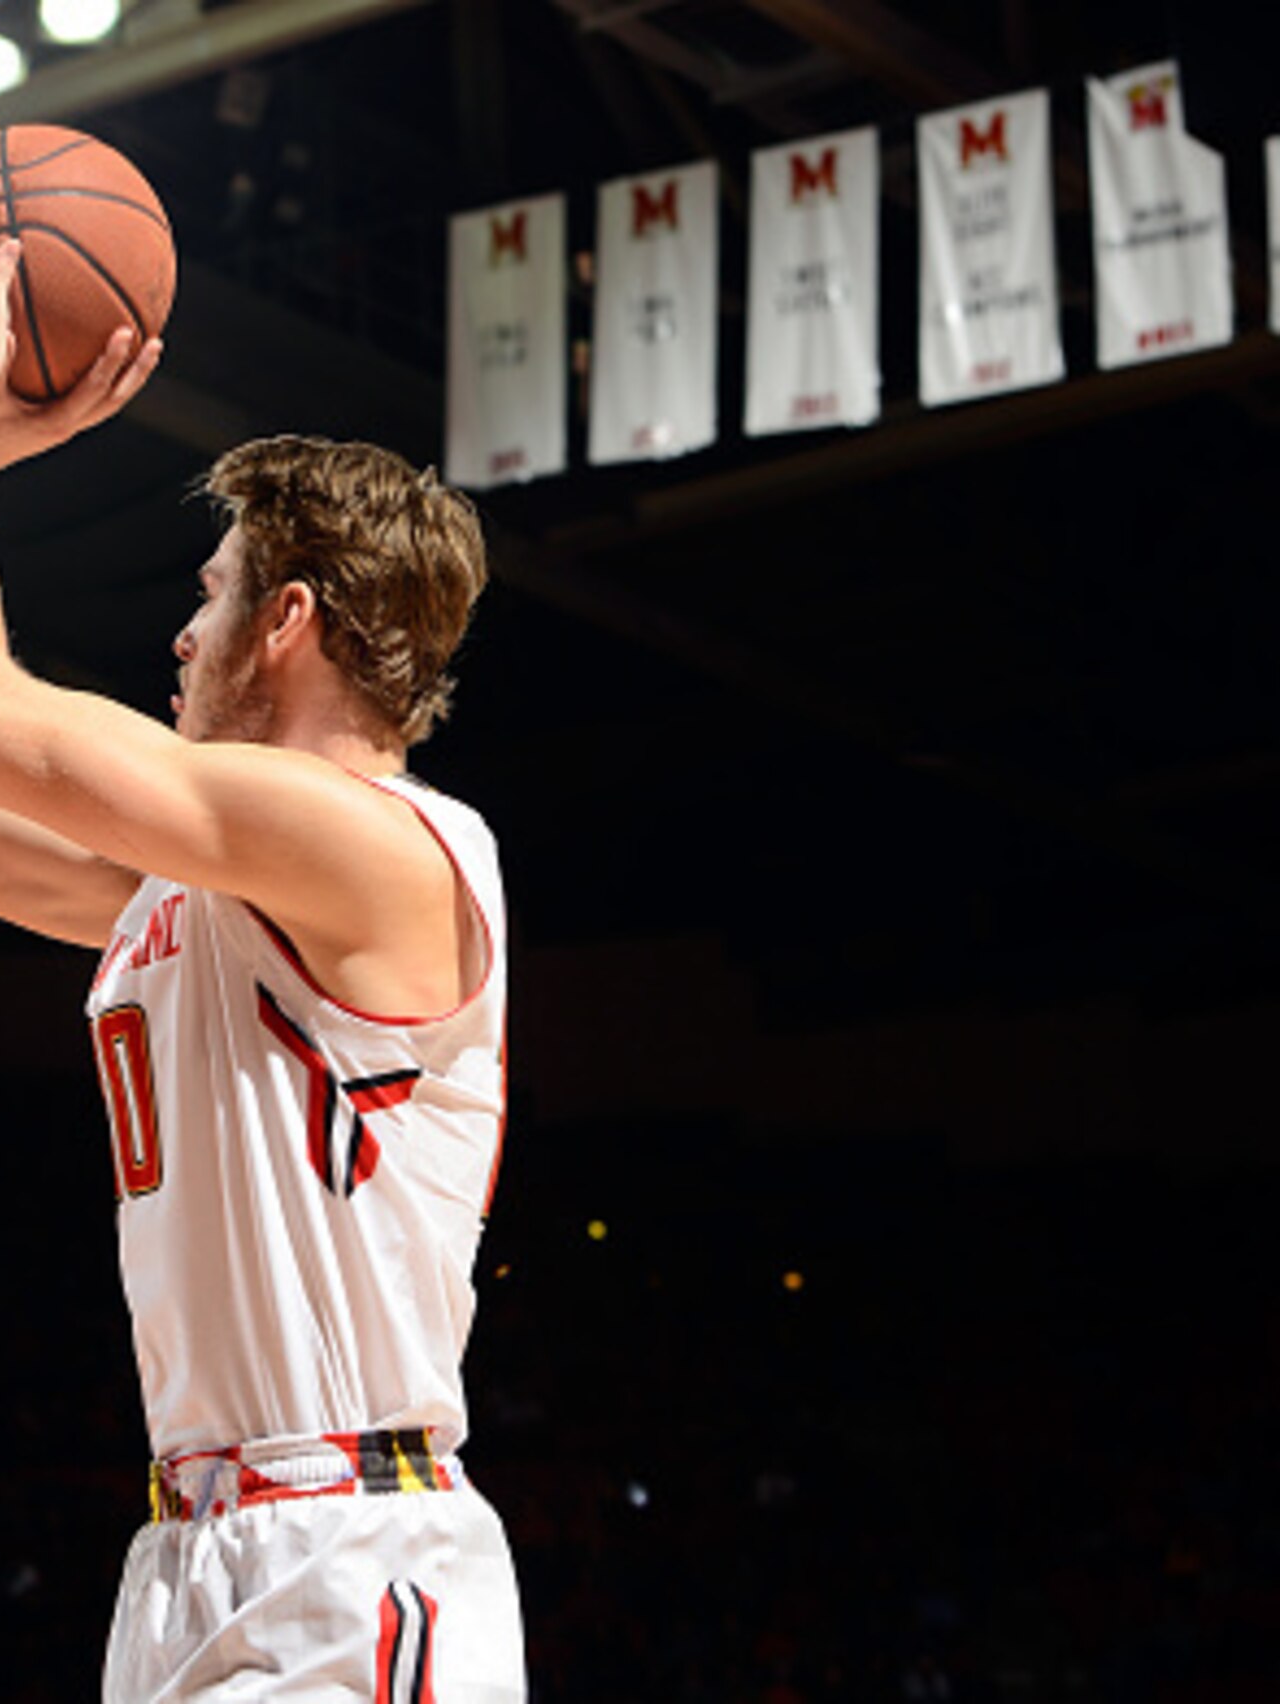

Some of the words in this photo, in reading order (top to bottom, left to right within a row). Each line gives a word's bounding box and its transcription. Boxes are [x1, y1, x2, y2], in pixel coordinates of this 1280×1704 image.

[958, 110, 1010, 171] M
[789, 146, 838, 205] M
[630, 178, 679, 240] M
[488, 212, 528, 270] M
[89, 1001, 164, 1202] 0
